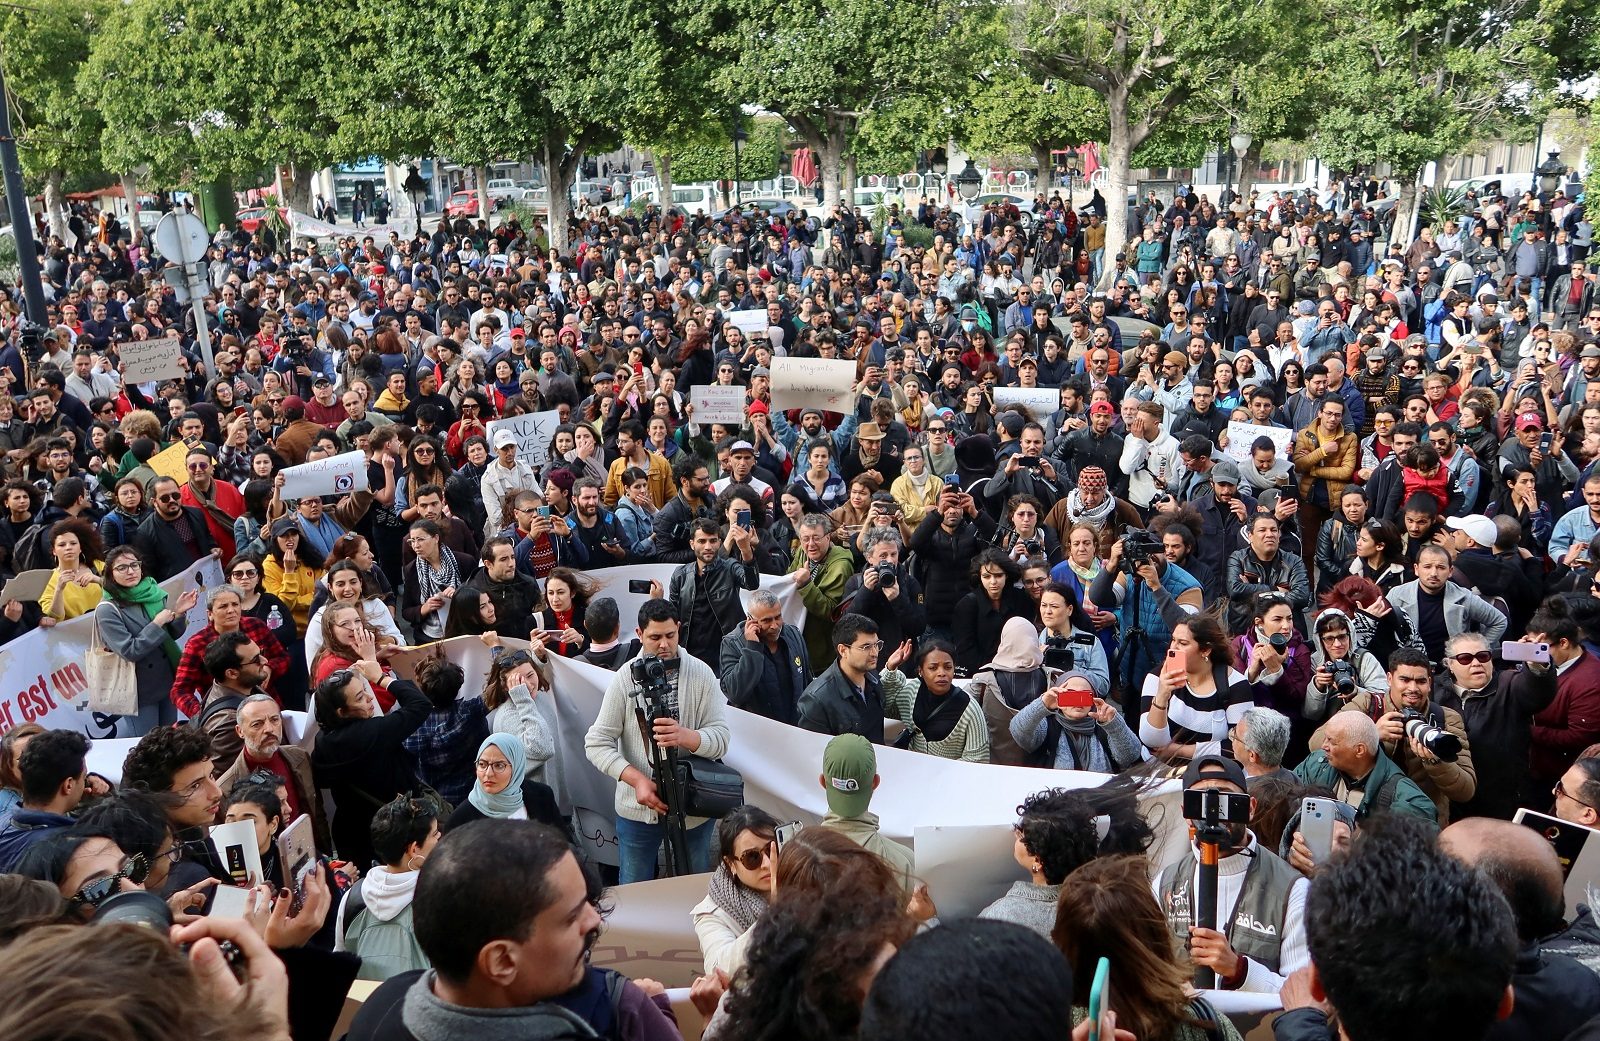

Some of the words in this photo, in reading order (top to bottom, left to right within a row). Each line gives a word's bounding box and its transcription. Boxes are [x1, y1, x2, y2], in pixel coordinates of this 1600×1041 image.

[778, 362, 791, 372] All
[800, 364, 834, 375] Migrants
[17, 674, 58, 723] est
[51, 662, 89, 700] un
[1235, 910, 1277, 936] صحافة
